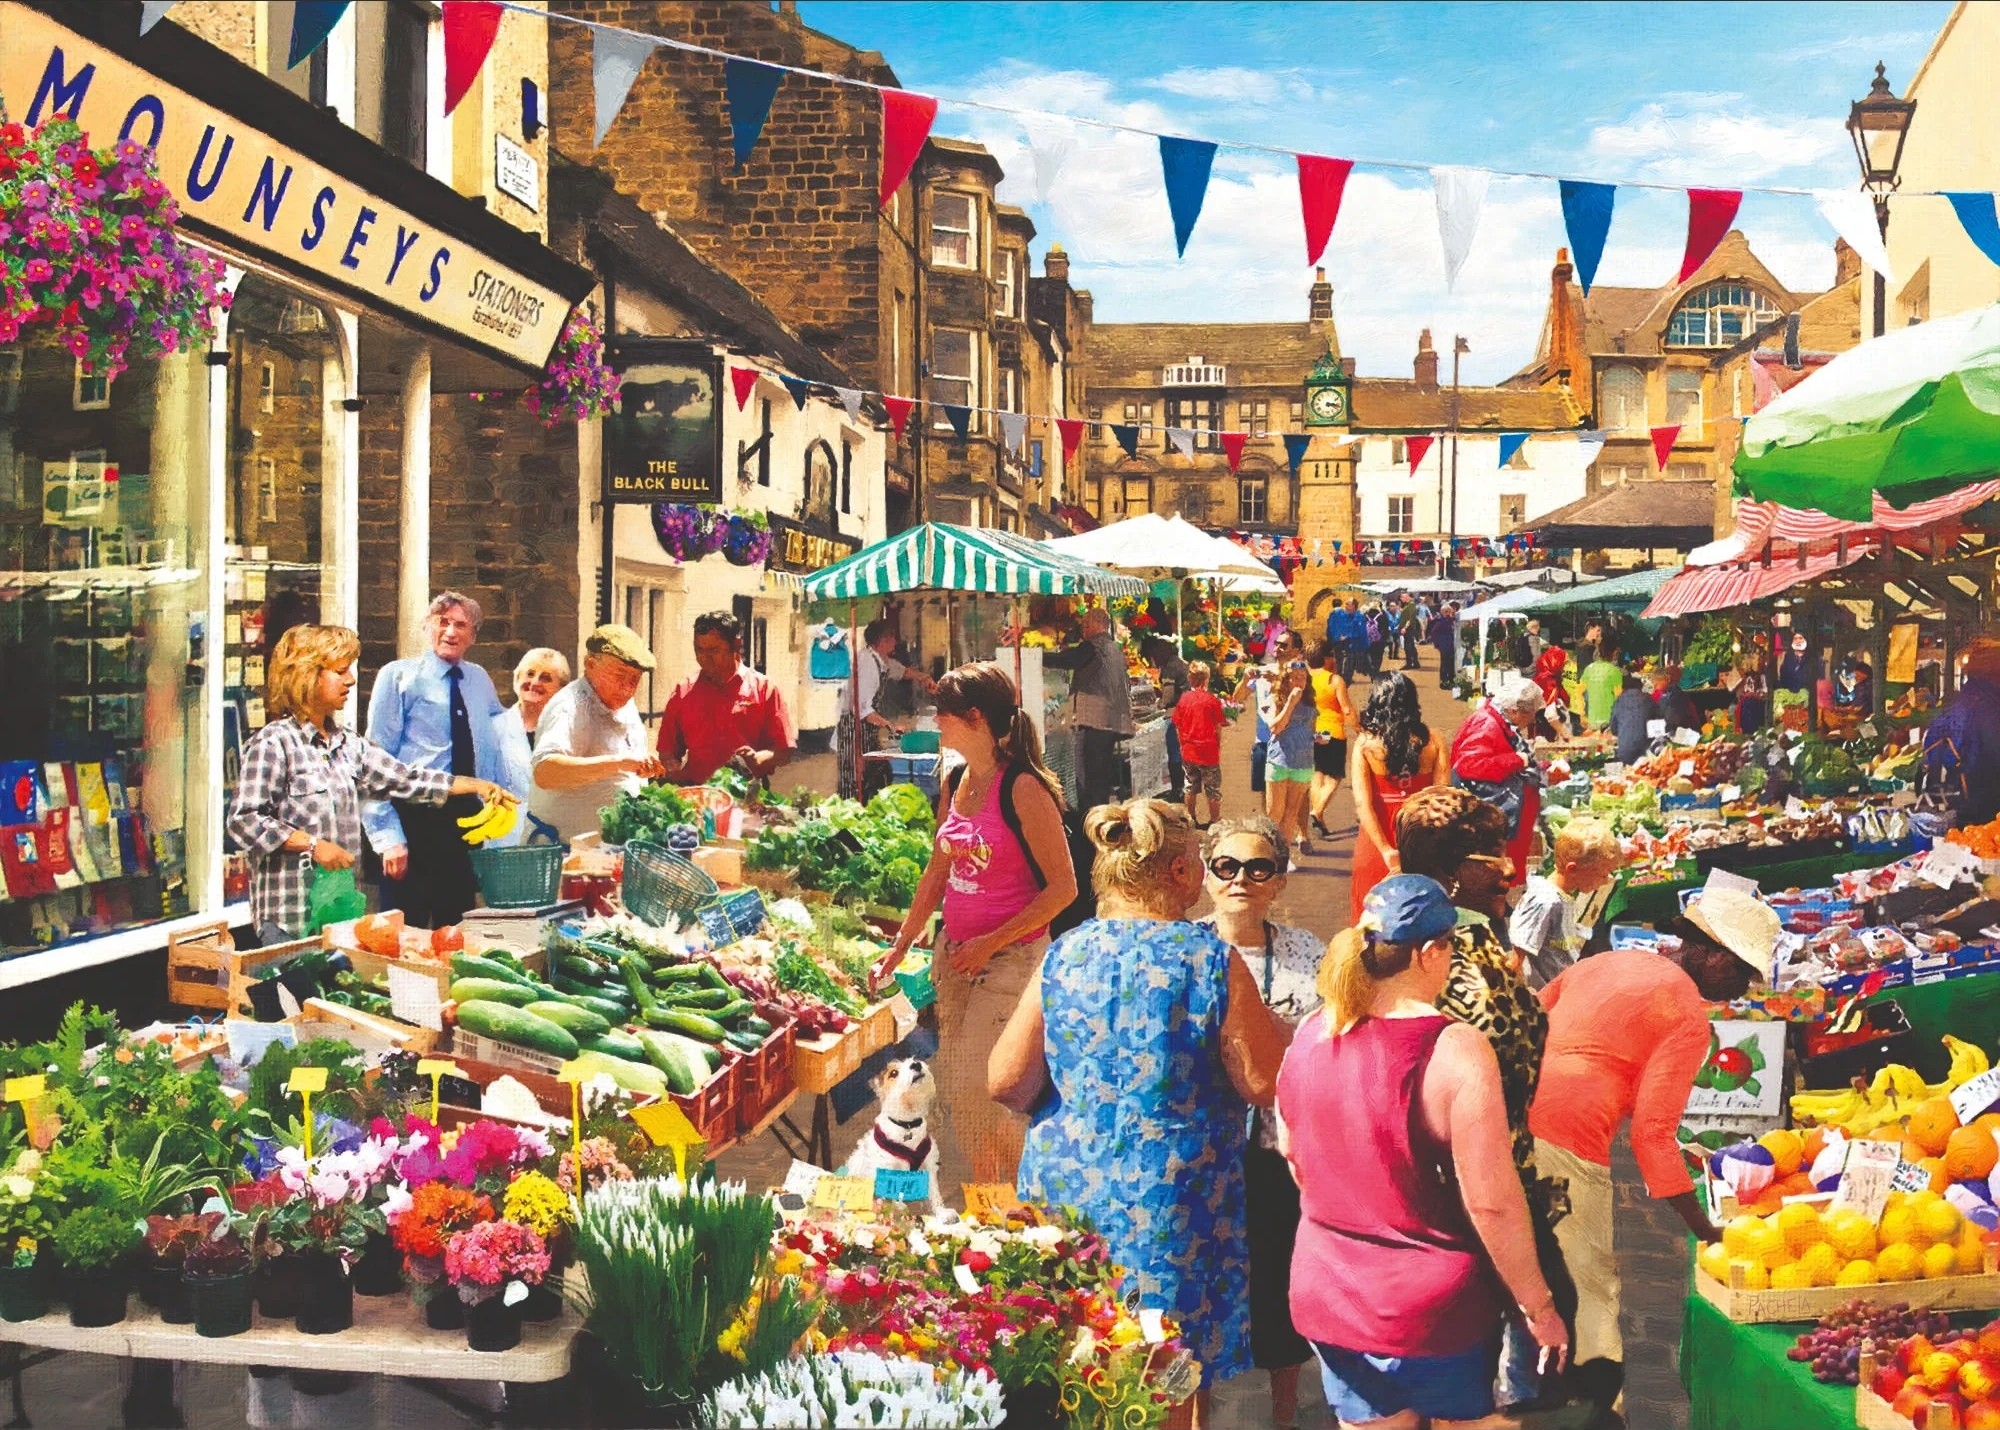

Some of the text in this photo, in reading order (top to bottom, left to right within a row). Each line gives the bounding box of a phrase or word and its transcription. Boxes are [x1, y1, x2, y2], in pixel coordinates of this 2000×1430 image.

[25, 45, 450, 302] MOUNSEYS
[468, 269, 545, 327] STATIONERS
[614, 475, 709, 491] BLACK BULL
[647, 460, 677, 474] THE
